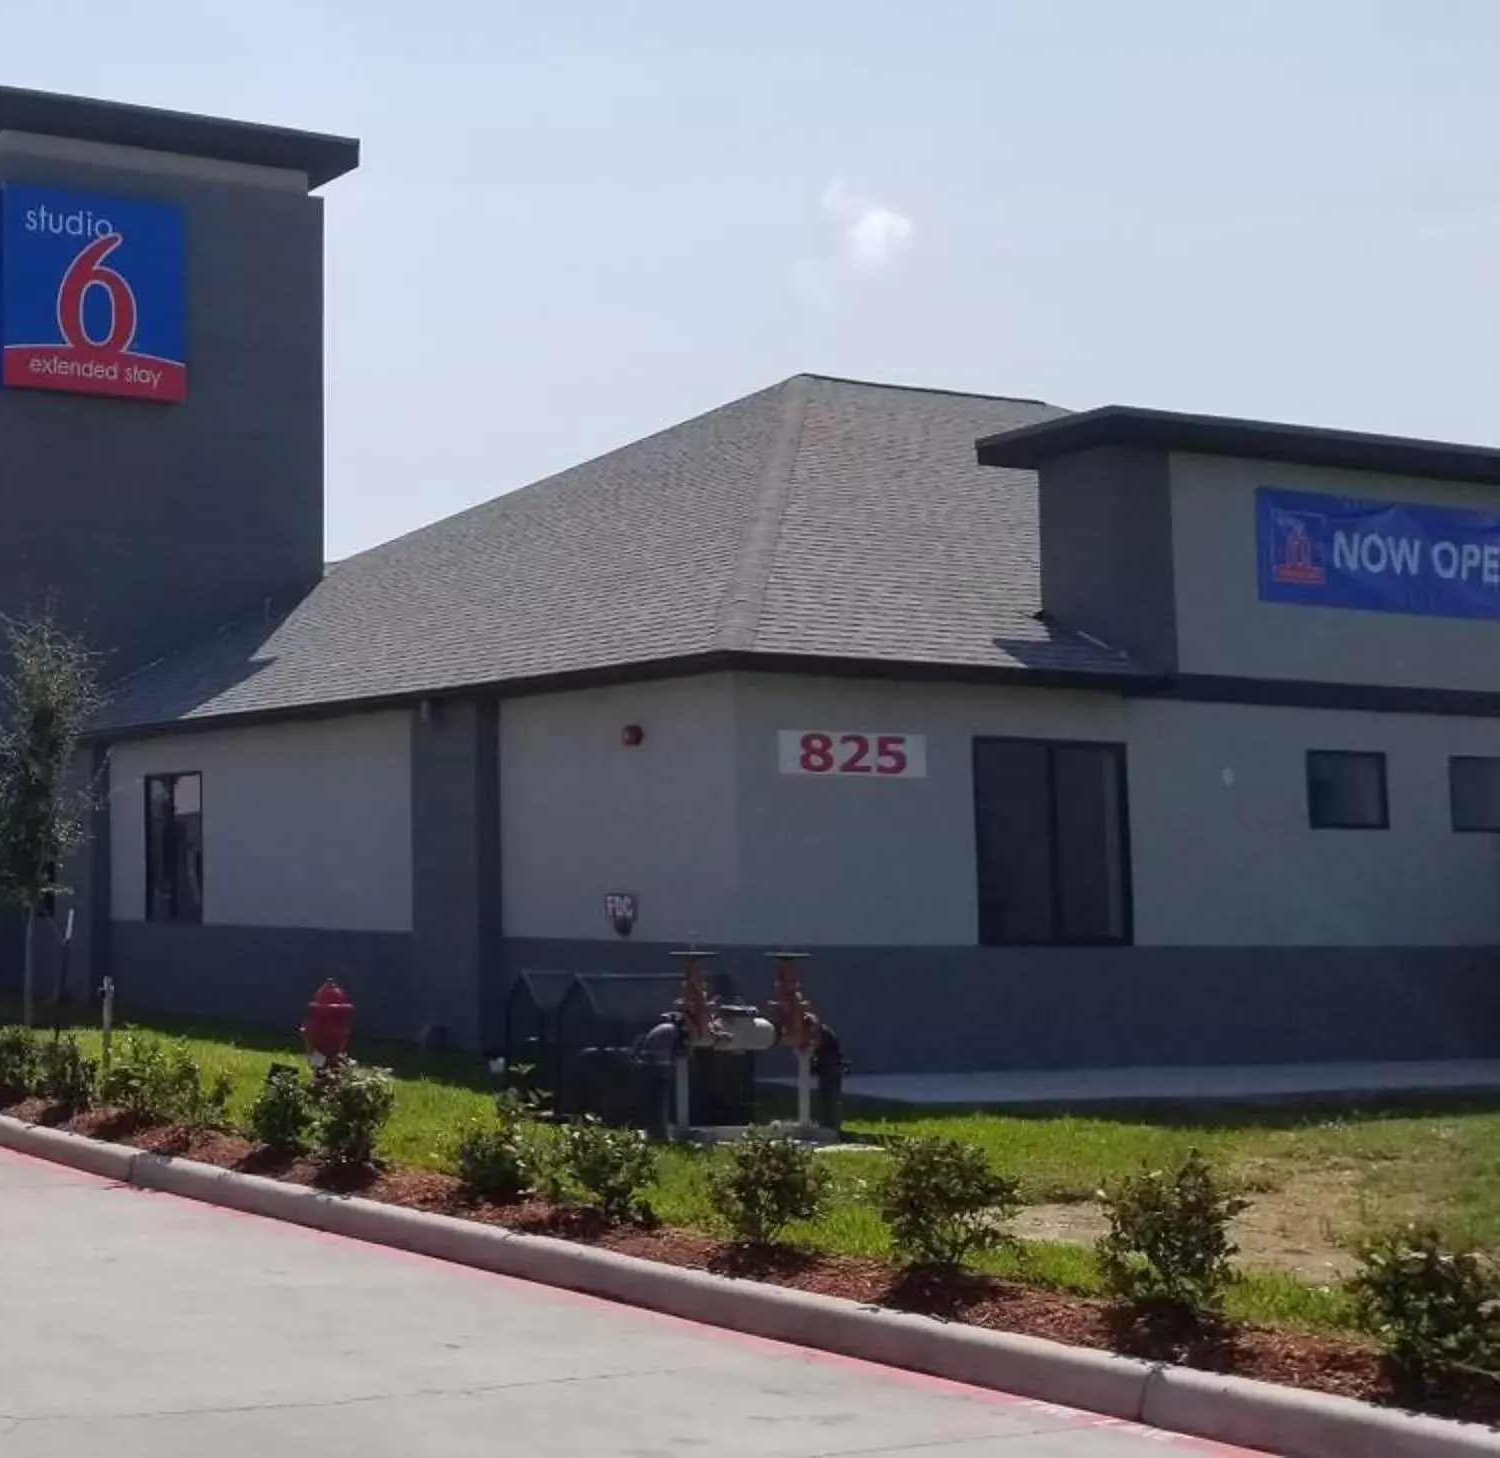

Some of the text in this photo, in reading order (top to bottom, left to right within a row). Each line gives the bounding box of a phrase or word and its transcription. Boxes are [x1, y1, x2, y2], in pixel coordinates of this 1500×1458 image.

[25, 204, 113, 239] studio
[56, 232, 137, 353] 6
[29, 355, 163, 390] extended stay
[1333, 530, 1421, 576] NOW
[800, 733, 907, 774] 825
[606, 895, 633, 918] FDC
